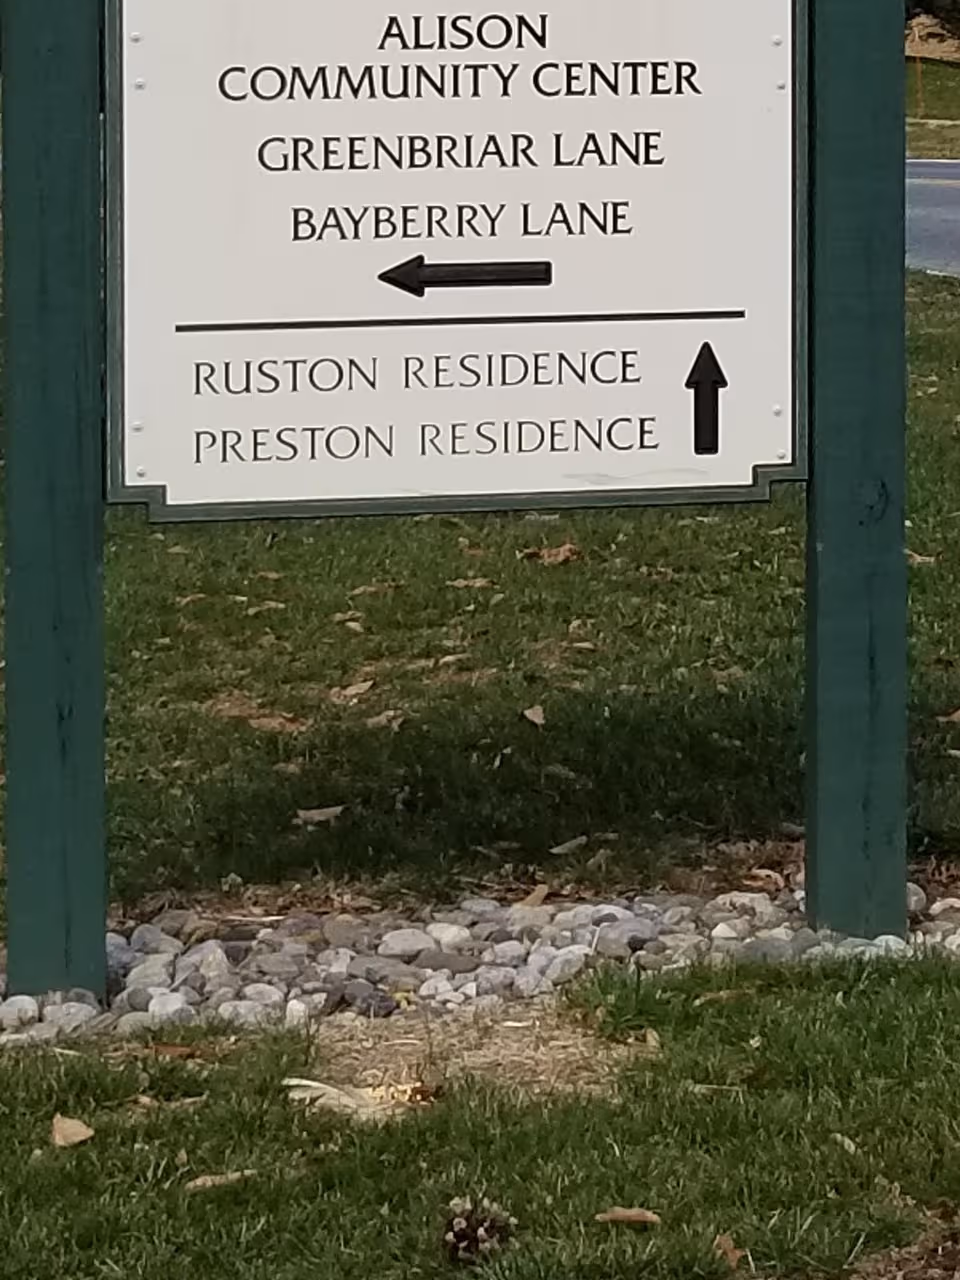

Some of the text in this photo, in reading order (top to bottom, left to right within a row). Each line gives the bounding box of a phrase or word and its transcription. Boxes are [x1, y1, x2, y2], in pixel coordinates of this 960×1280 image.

[377, 14, 548, 50] ALISON
[218, 61, 702, 101] COMMUNITY CENTER
[258, 131, 665, 171] GREENBRIAR LANE
[292, 201, 633, 241] BAYBERRY LANE
[194, 351, 641, 395] RUSTON RESIDENCE
[194, 417, 659, 463] PRESTON RESIDENCE
